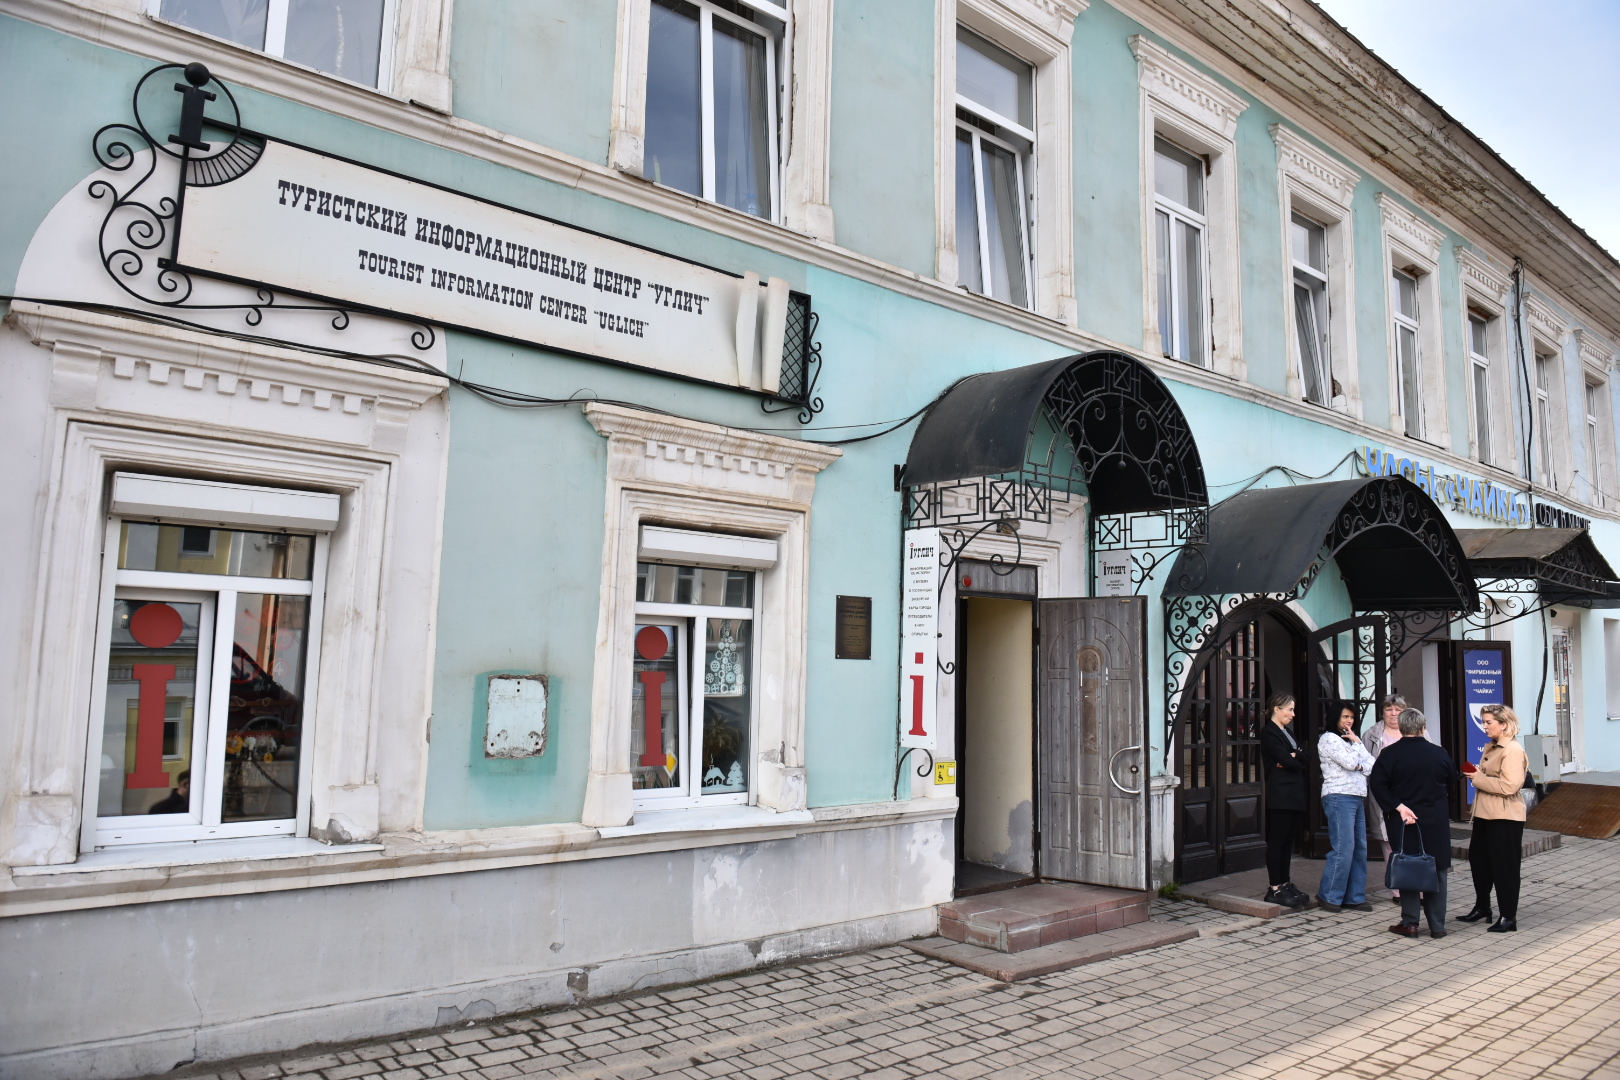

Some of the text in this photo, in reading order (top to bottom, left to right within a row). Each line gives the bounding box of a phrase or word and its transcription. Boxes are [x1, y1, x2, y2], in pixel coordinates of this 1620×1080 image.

[278, 179, 408, 237] ТУРИСТСКИЙ
[415, 217, 588, 285] ИНФОРМАЦИОННЫЙ
[593, 266, 642, 299] ЦЕНТР
[358, 249, 425, 284] TOURIST
[430, 268, 534, 310] INFORMATION
[539, 295, 588, 325] CENTER
[1363, 445, 1436, 501] ЧАСЫ
